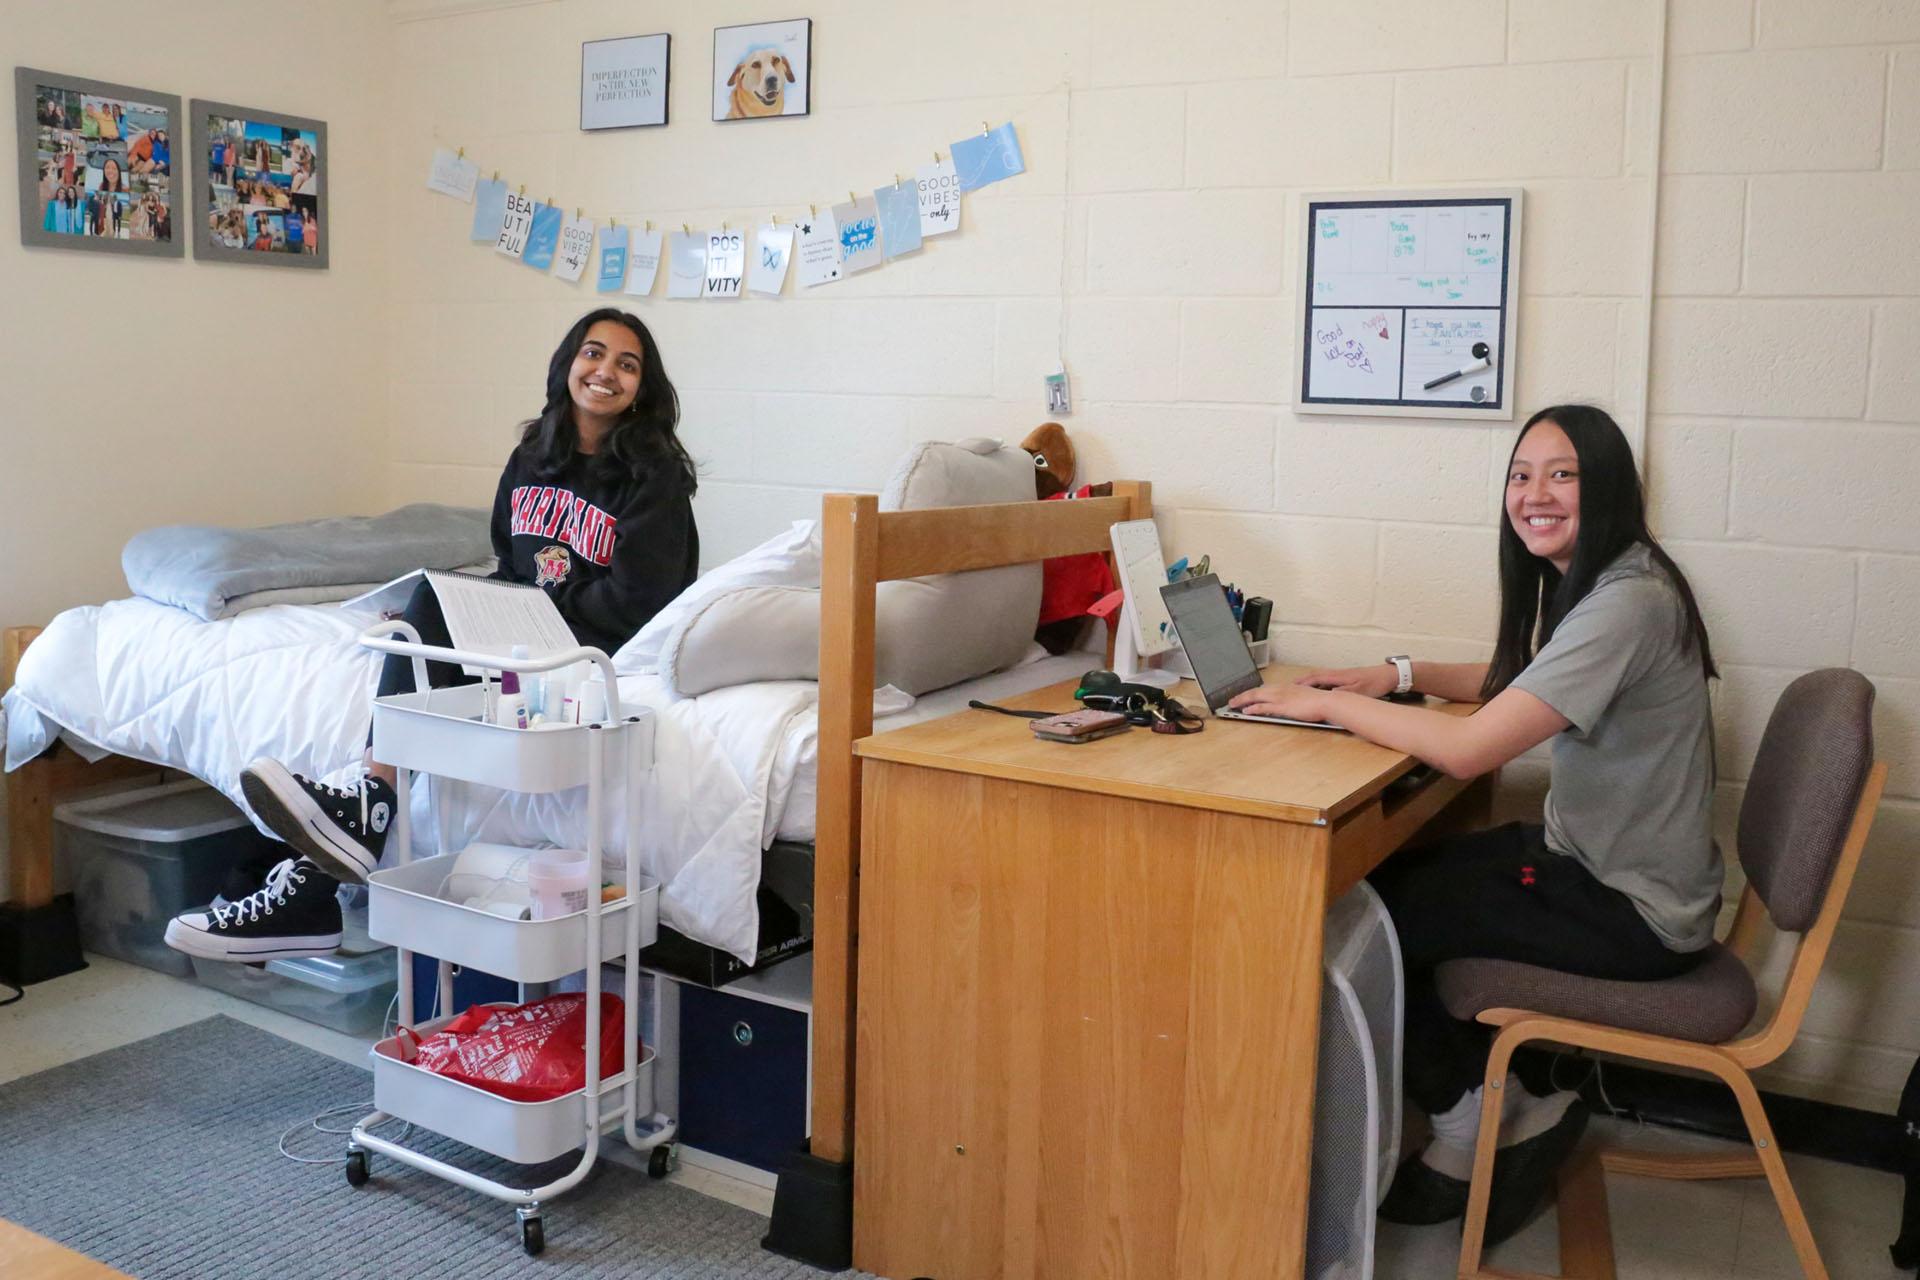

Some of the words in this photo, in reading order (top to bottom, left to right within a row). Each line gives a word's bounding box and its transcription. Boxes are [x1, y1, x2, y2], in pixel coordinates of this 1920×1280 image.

[918, 175, 960, 191] GOOD
[507, 194, 532, 216] BEA
[919, 189, 960, 206] VIBES
[930, 204, 950, 221] only
[563, 226, 593, 243] GOOD
[711, 235, 739, 251] POS
[497, 233, 521, 254] FUL
[563, 239, 589, 257] VIBES
[708, 278, 741, 292] VITY
[511, 486, 617, 566] MARYLAND
[780, 934, 811, 951] ARMO
